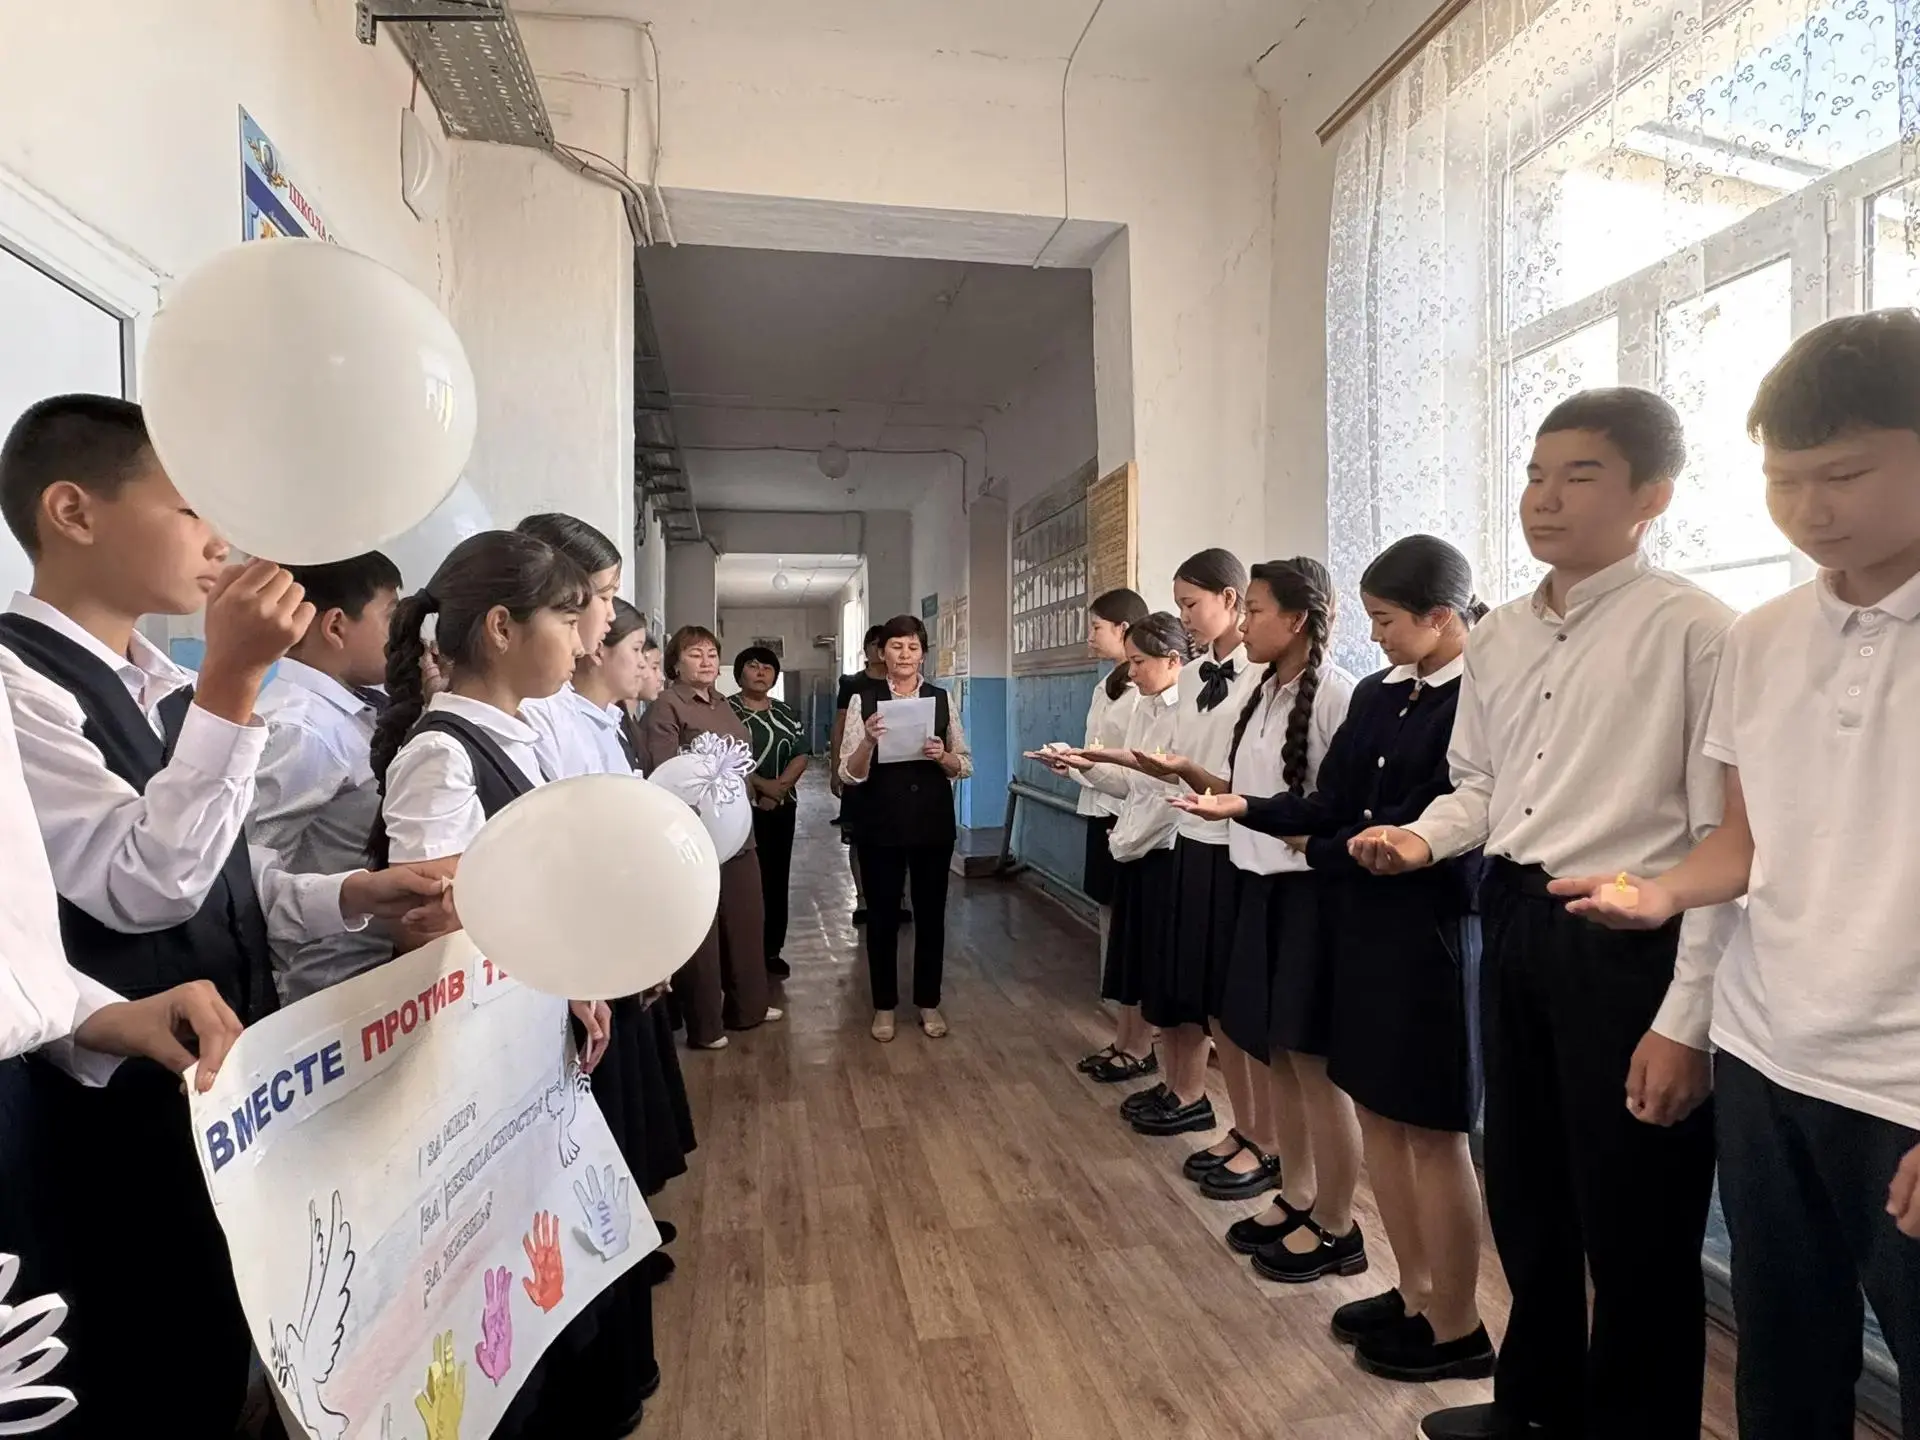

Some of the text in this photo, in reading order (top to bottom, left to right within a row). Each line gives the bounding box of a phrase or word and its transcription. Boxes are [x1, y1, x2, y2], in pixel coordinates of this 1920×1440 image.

[288, 179, 327, 242] ШКОЛА
[206, 969, 465, 1174] ВМЕСТЕ ПРОТИВ
[423, 1198, 441, 1233] ЗА
[423, 1260, 442, 1297] ЗА
